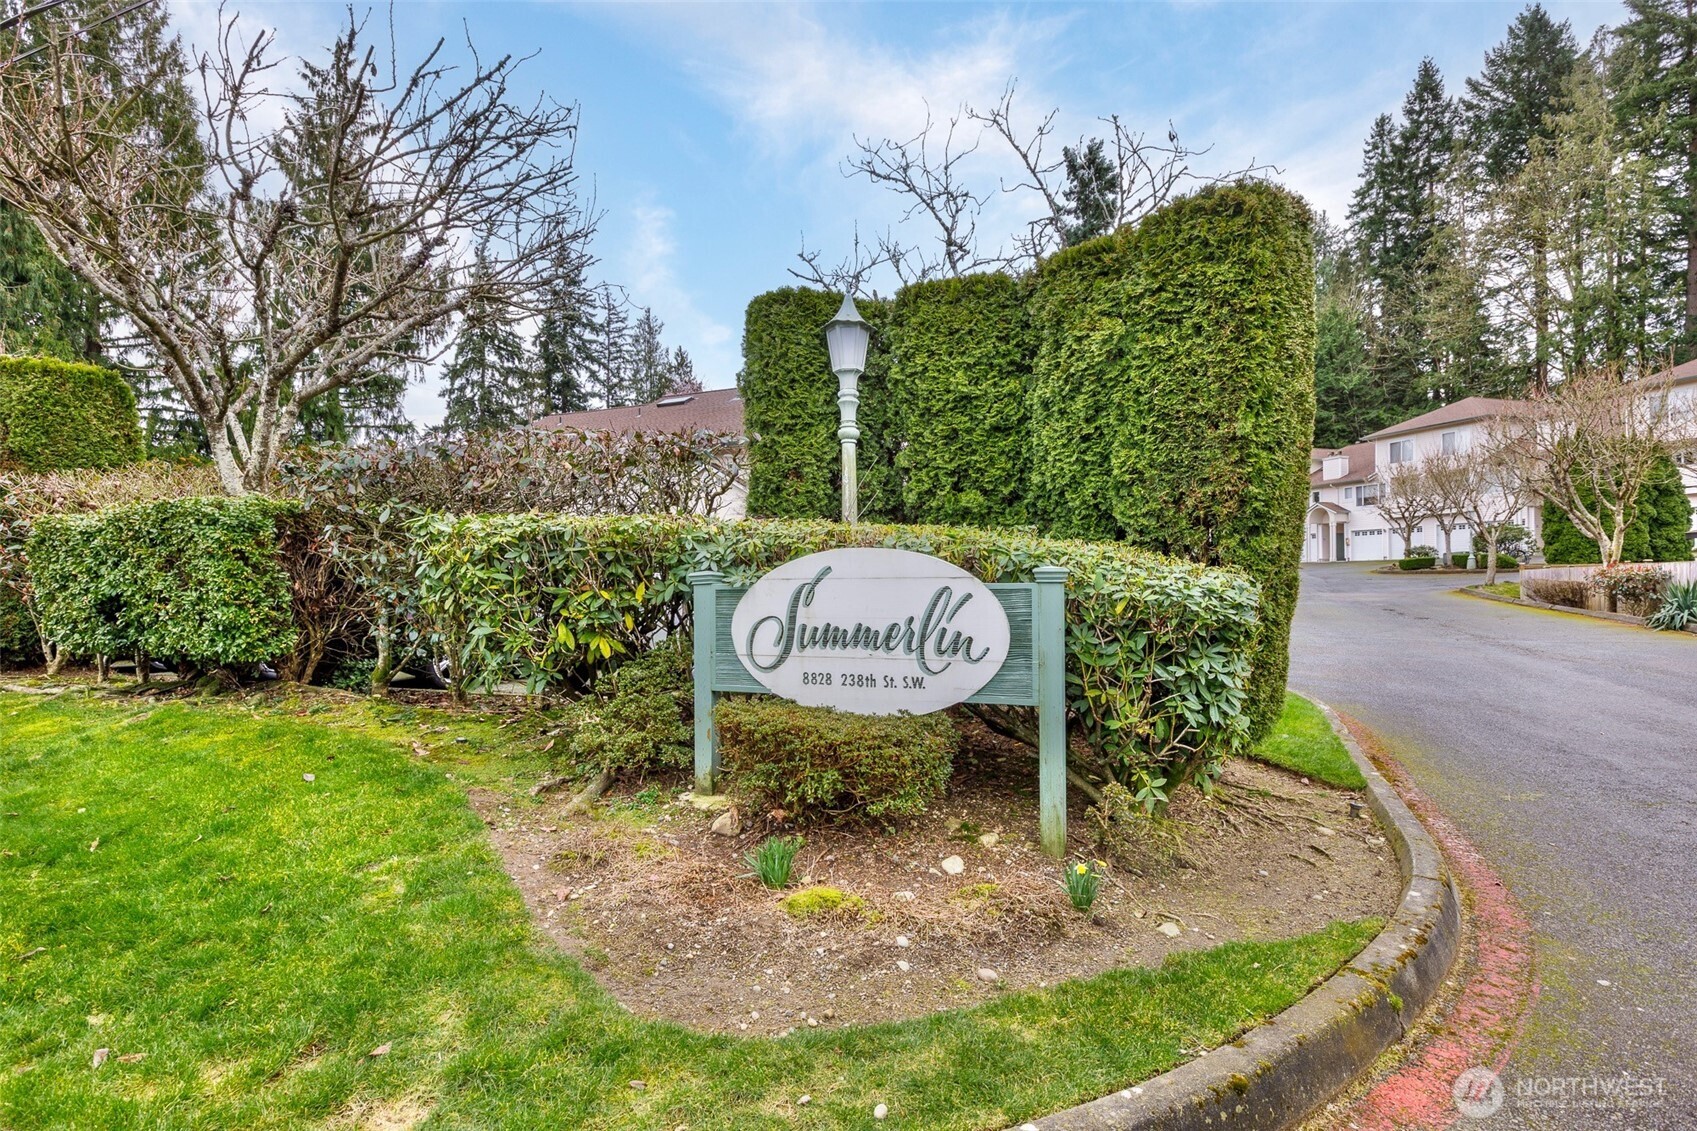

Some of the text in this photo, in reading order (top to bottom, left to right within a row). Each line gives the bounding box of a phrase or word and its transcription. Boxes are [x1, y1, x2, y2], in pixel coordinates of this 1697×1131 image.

[746, 566, 990, 676] Summerlin
[802, 672, 926, 689] 8828 238th St. S.W.
